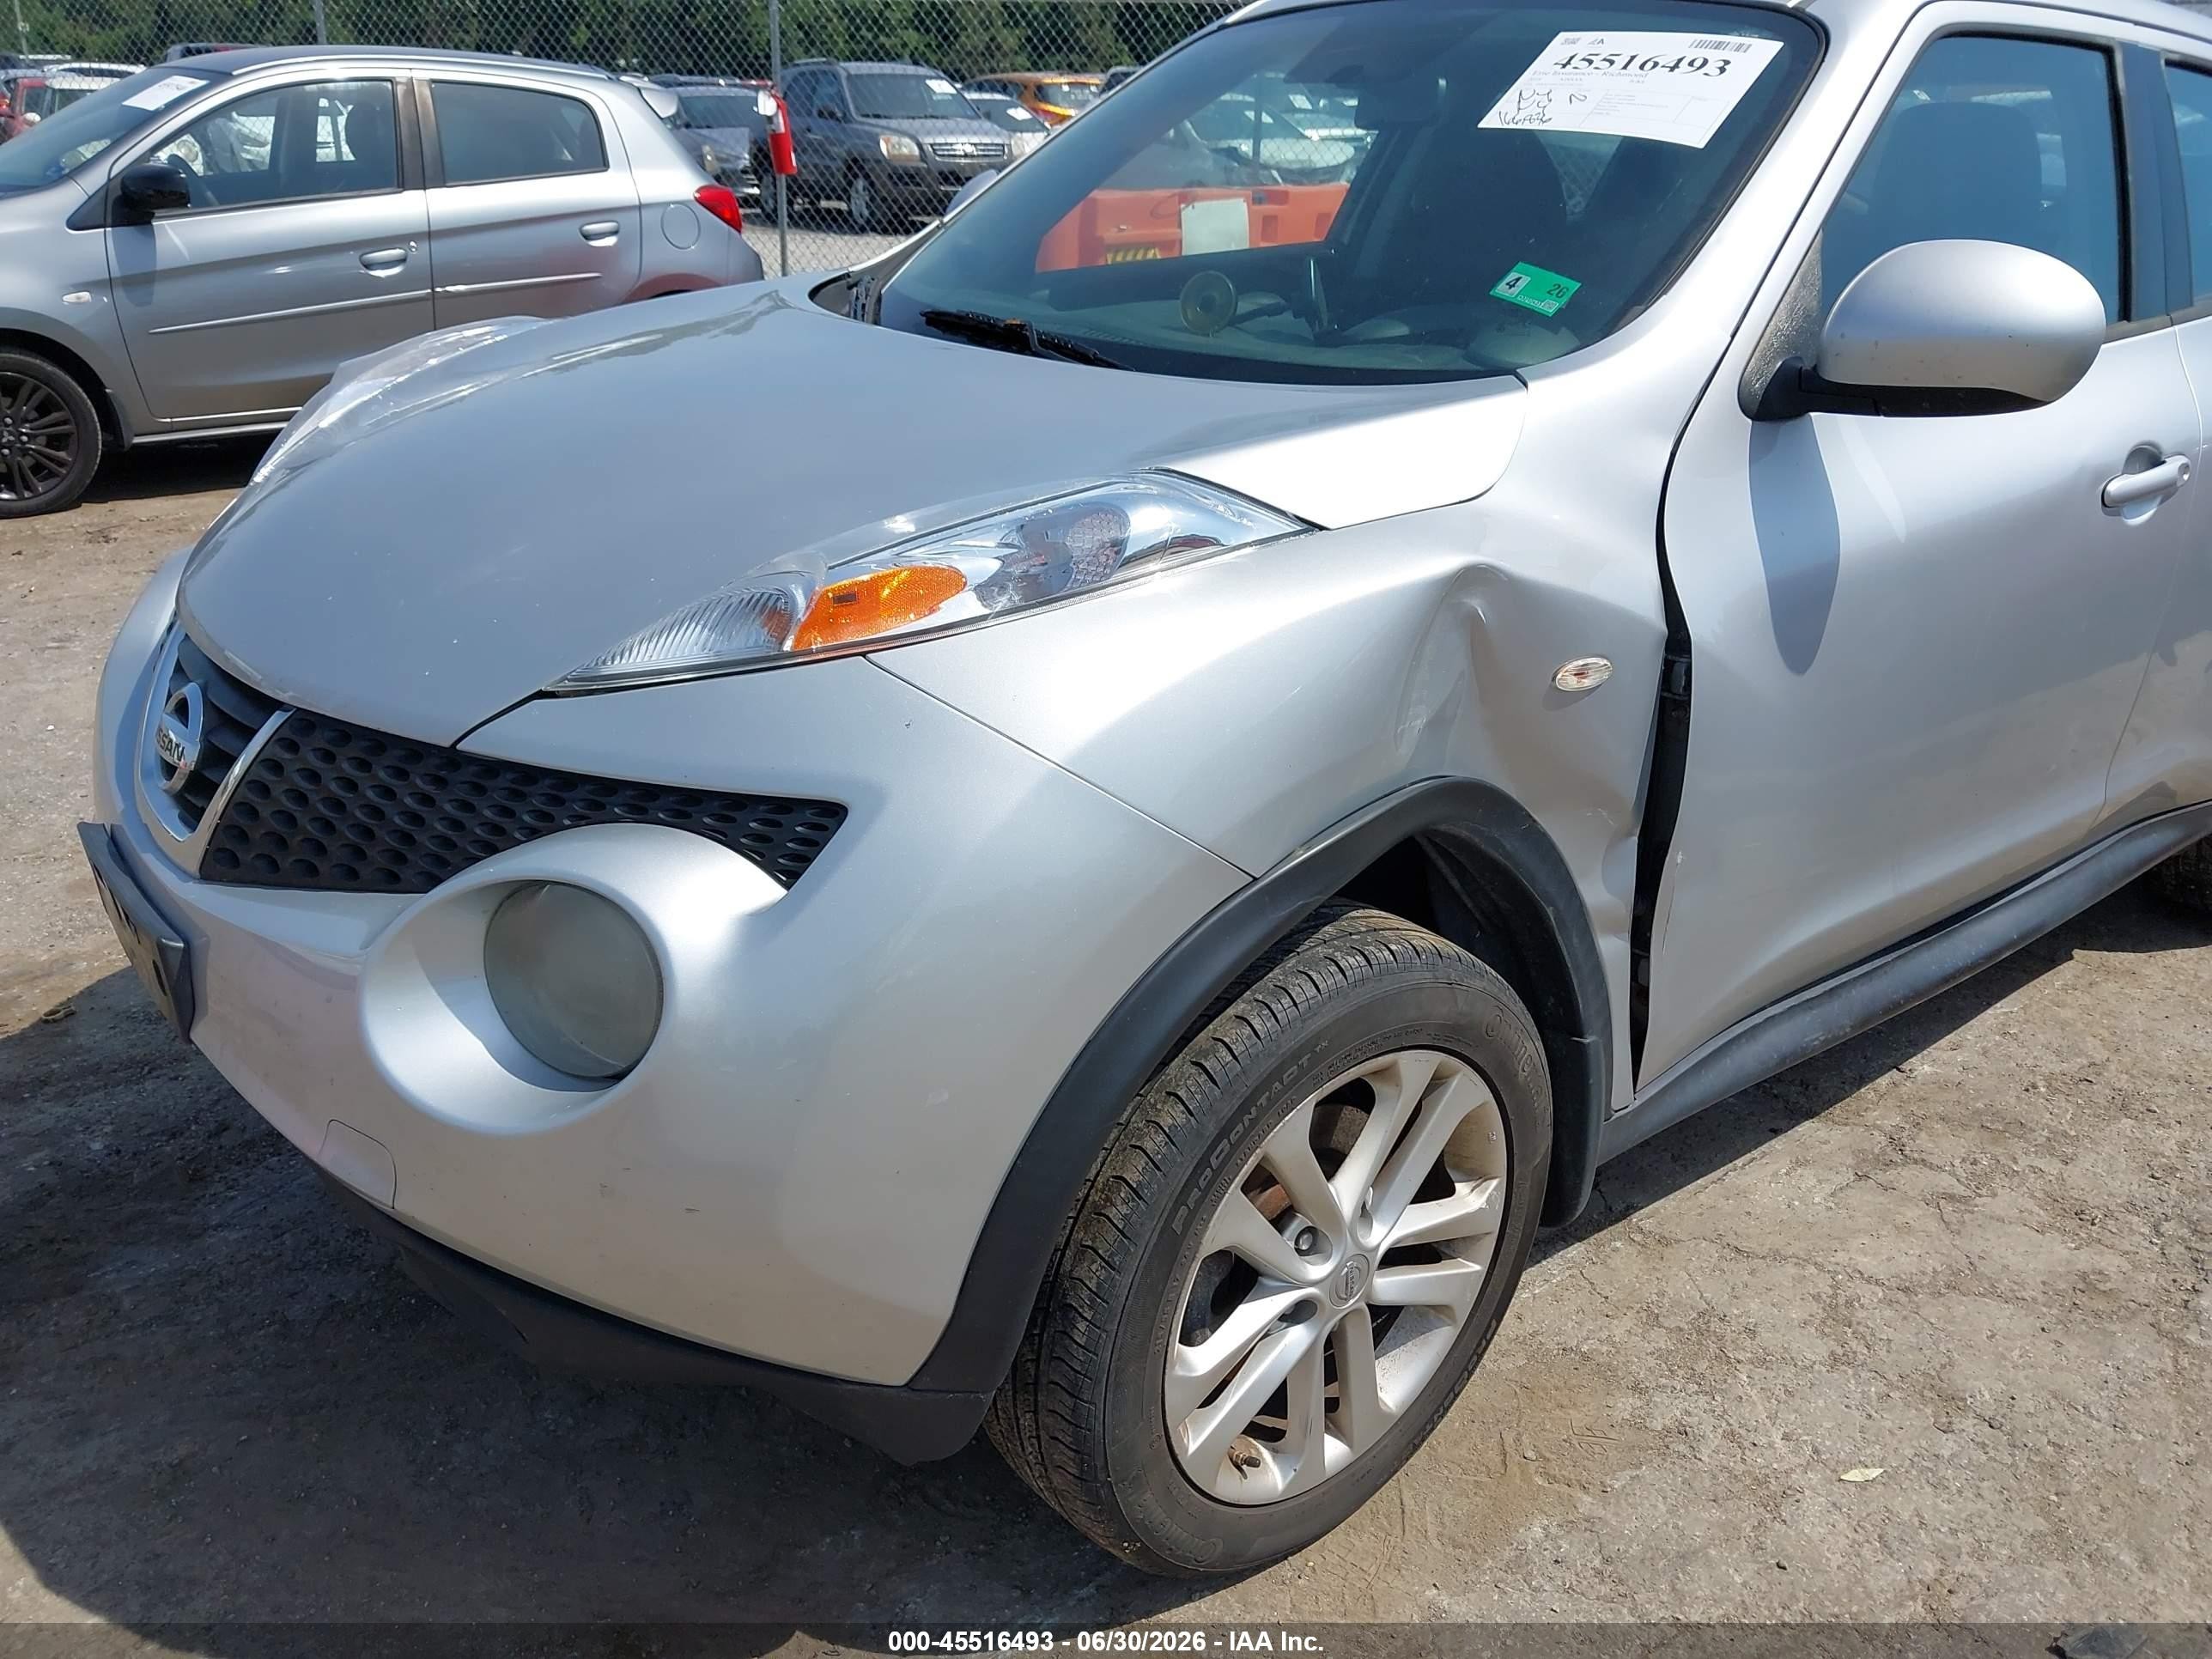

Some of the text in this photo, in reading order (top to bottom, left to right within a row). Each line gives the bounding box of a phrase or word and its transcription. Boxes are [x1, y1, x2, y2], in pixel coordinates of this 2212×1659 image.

[1553, 52, 1732, 77] 45516493
[1505, 276, 1523, 290] 4
[156, 728, 185, 762] SSAN
